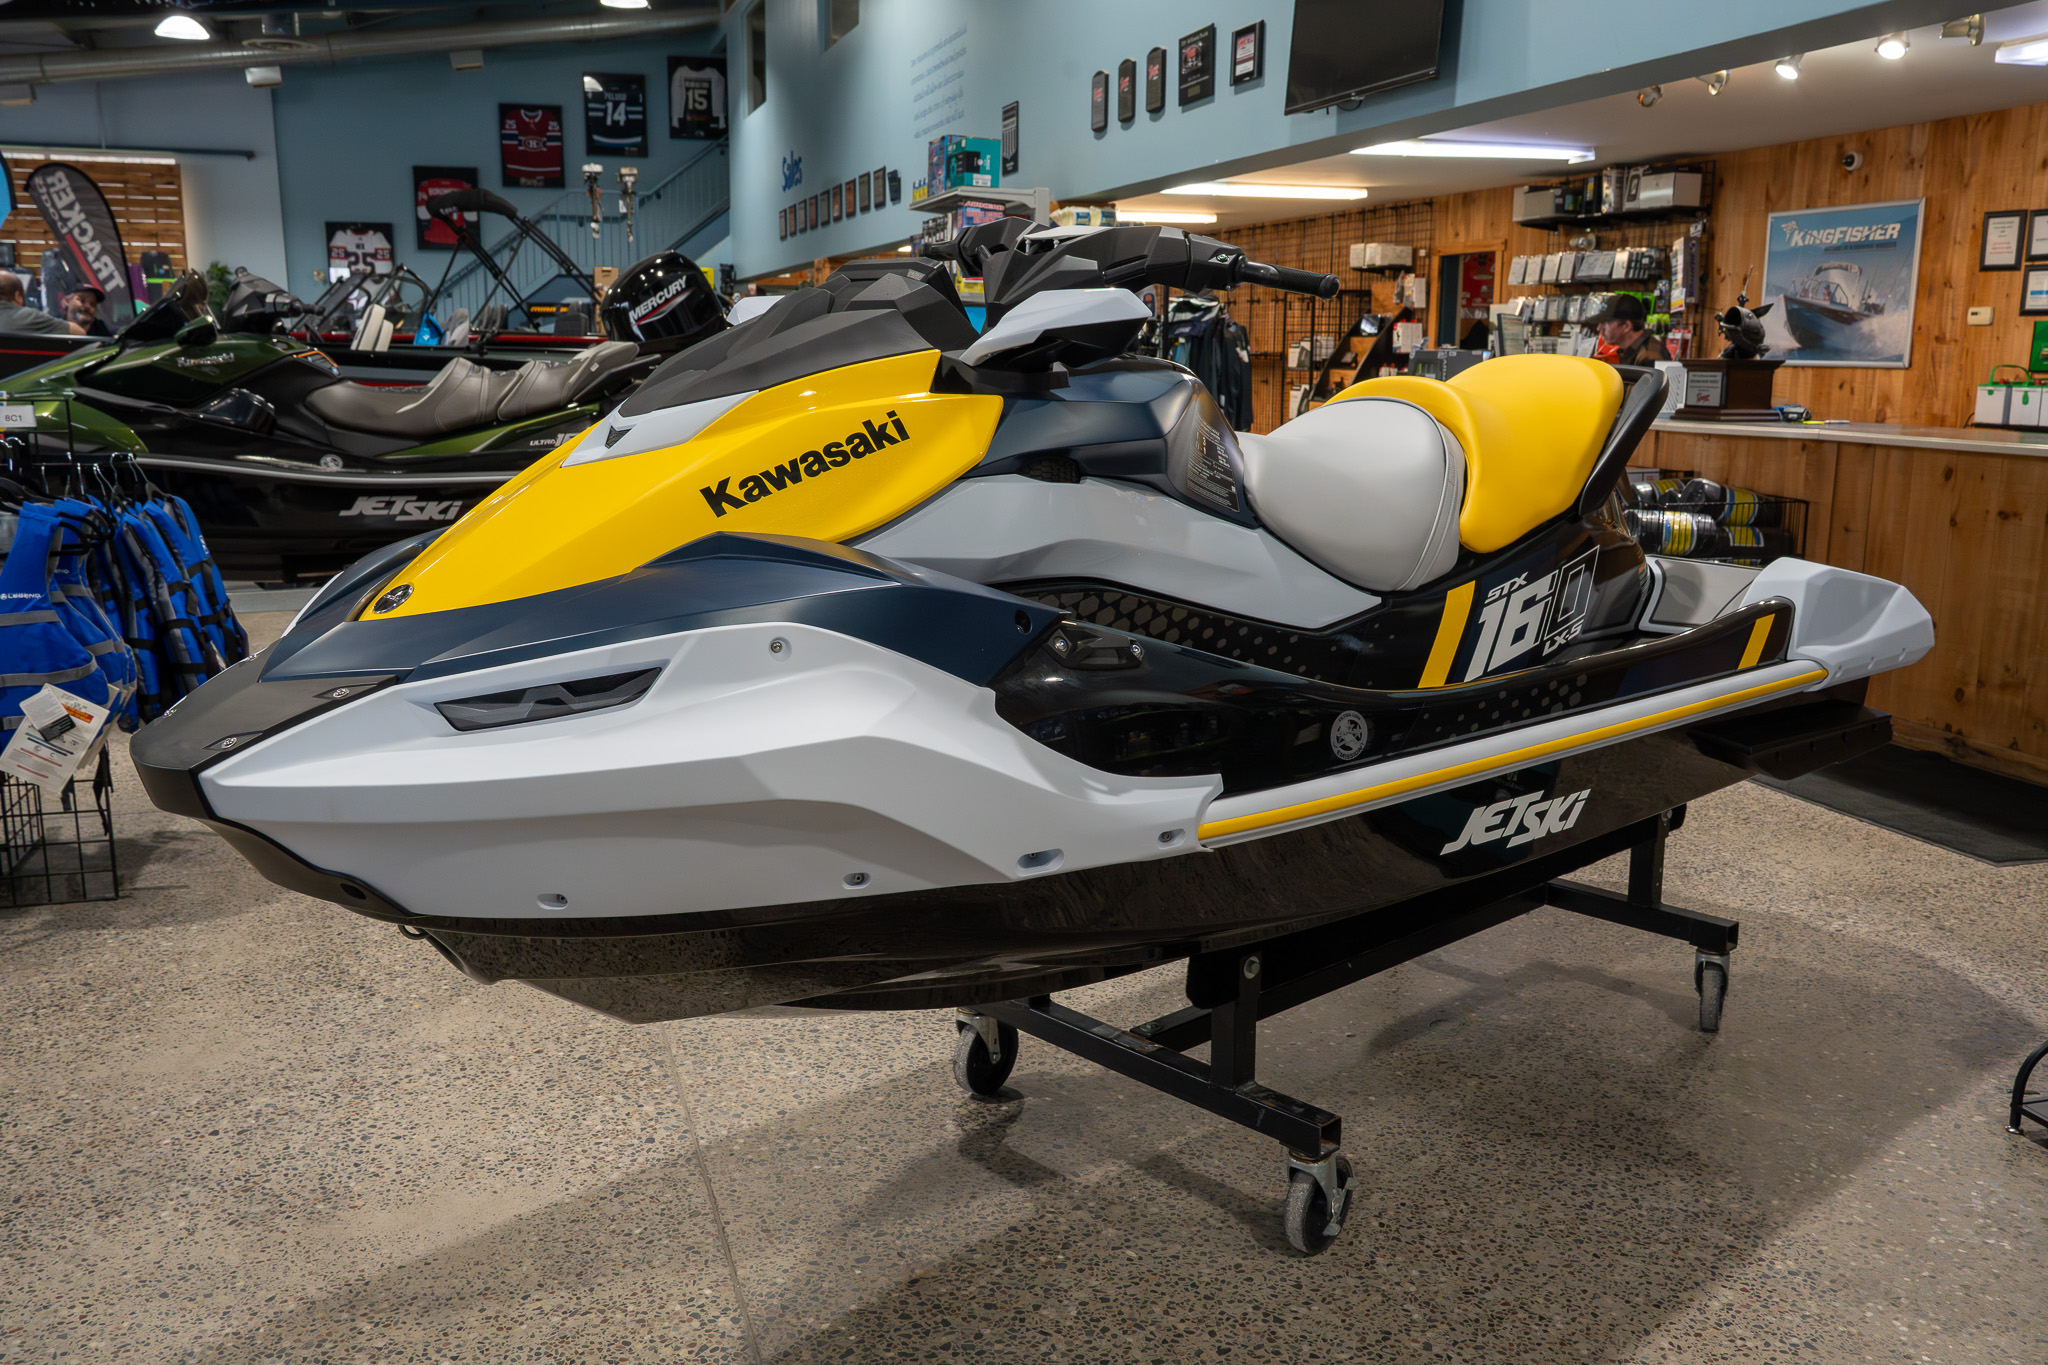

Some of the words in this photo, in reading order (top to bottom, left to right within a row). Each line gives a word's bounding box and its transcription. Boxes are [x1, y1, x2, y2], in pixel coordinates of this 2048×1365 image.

[605, 101, 627, 126] 14
[687, 88, 707, 110] 15
[1790, 222, 1901, 247] KINGFISHER
[629, 275, 688, 321] MERCURY
[5, 414, 23, 422] 8C1
[699, 409, 911, 518] Kawasaki
[1485, 571, 1529, 604] STX
[1463, 544, 1600, 683] 160
